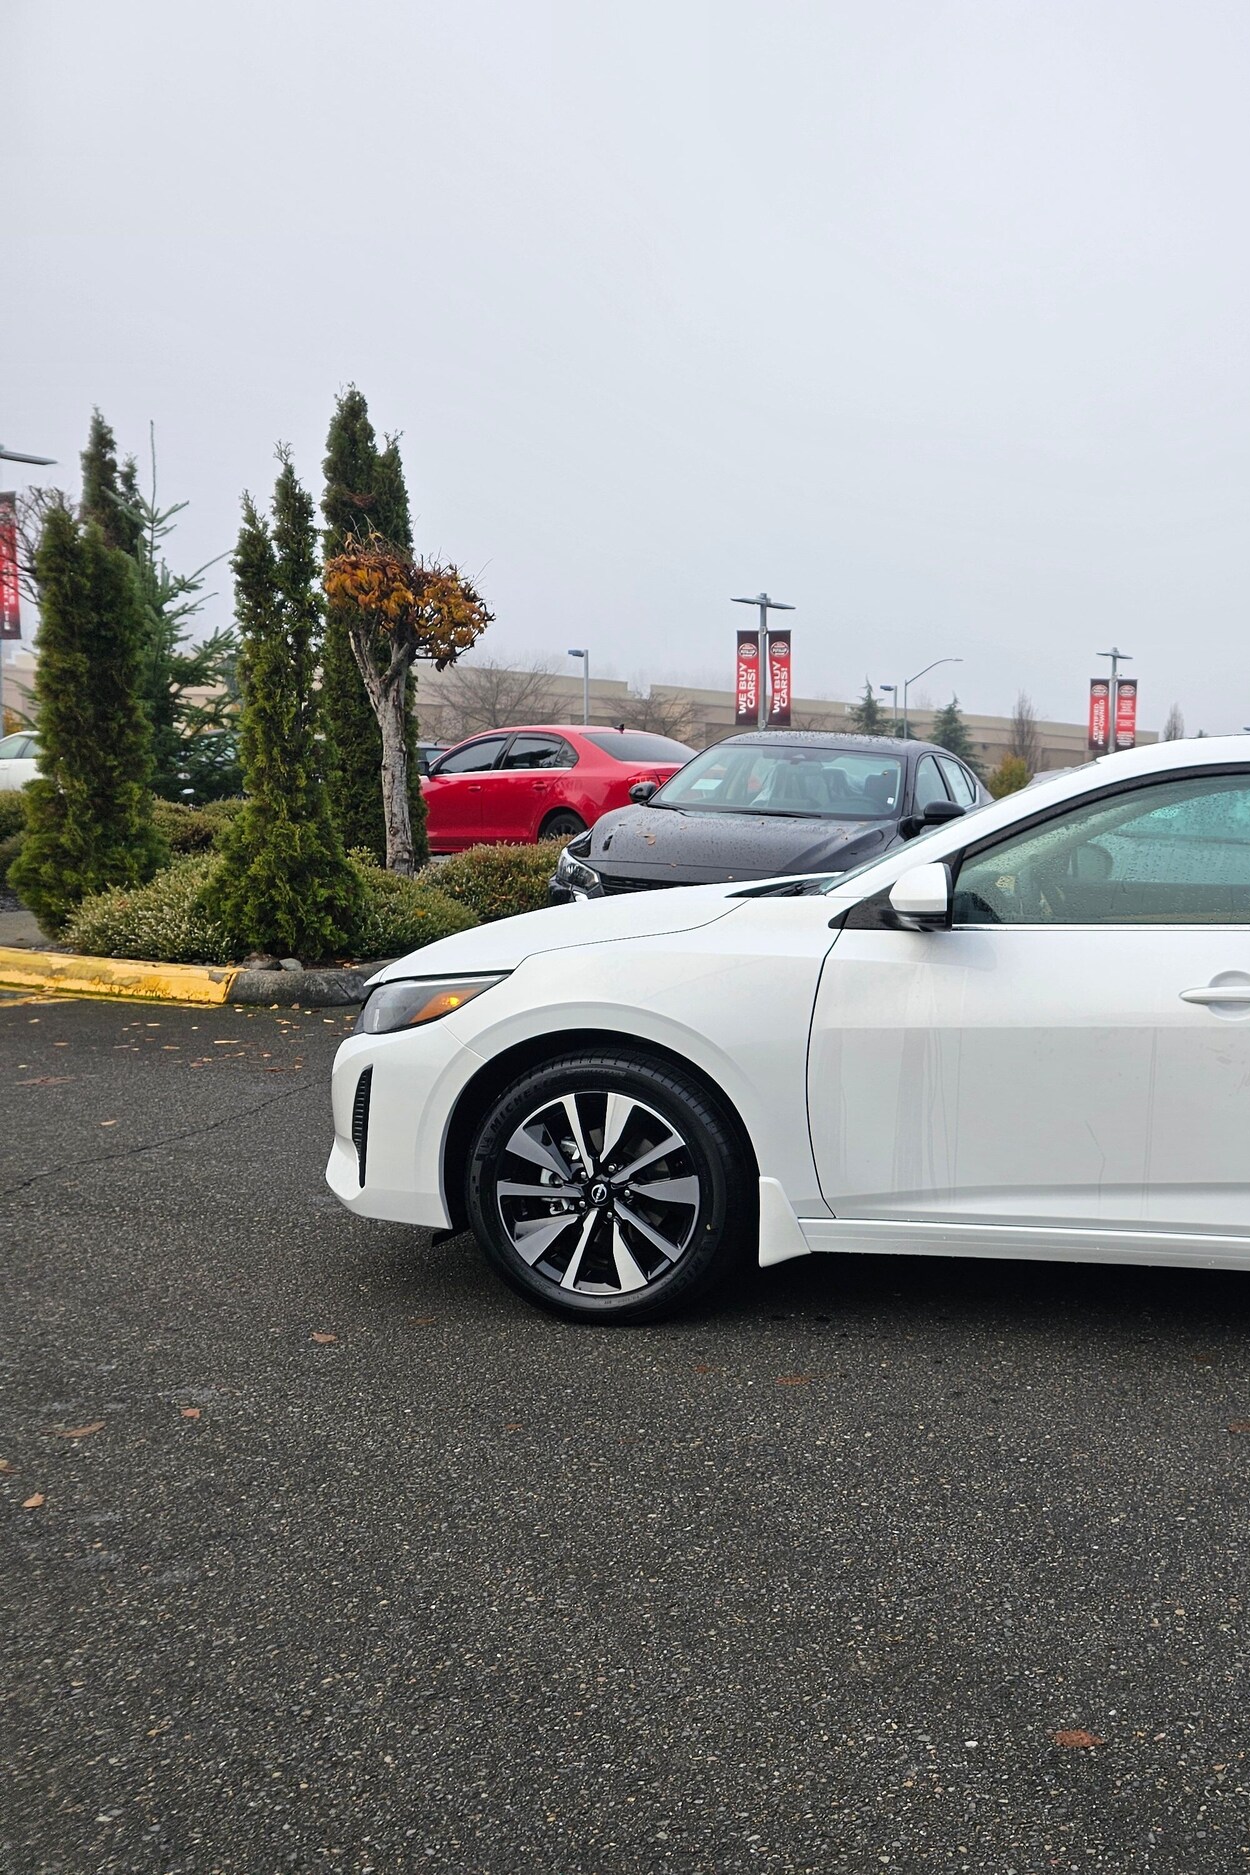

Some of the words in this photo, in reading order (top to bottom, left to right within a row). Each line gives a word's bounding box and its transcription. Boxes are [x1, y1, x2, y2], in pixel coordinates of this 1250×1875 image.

[738, 662, 747, 690] BUY
[747, 669, 756, 708] CARS!
[773, 661, 781, 689] BUY
[780, 668, 788, 707] CARS!
[738, 692, 747, 714] WE
[772, 692, 781, 713] WE
